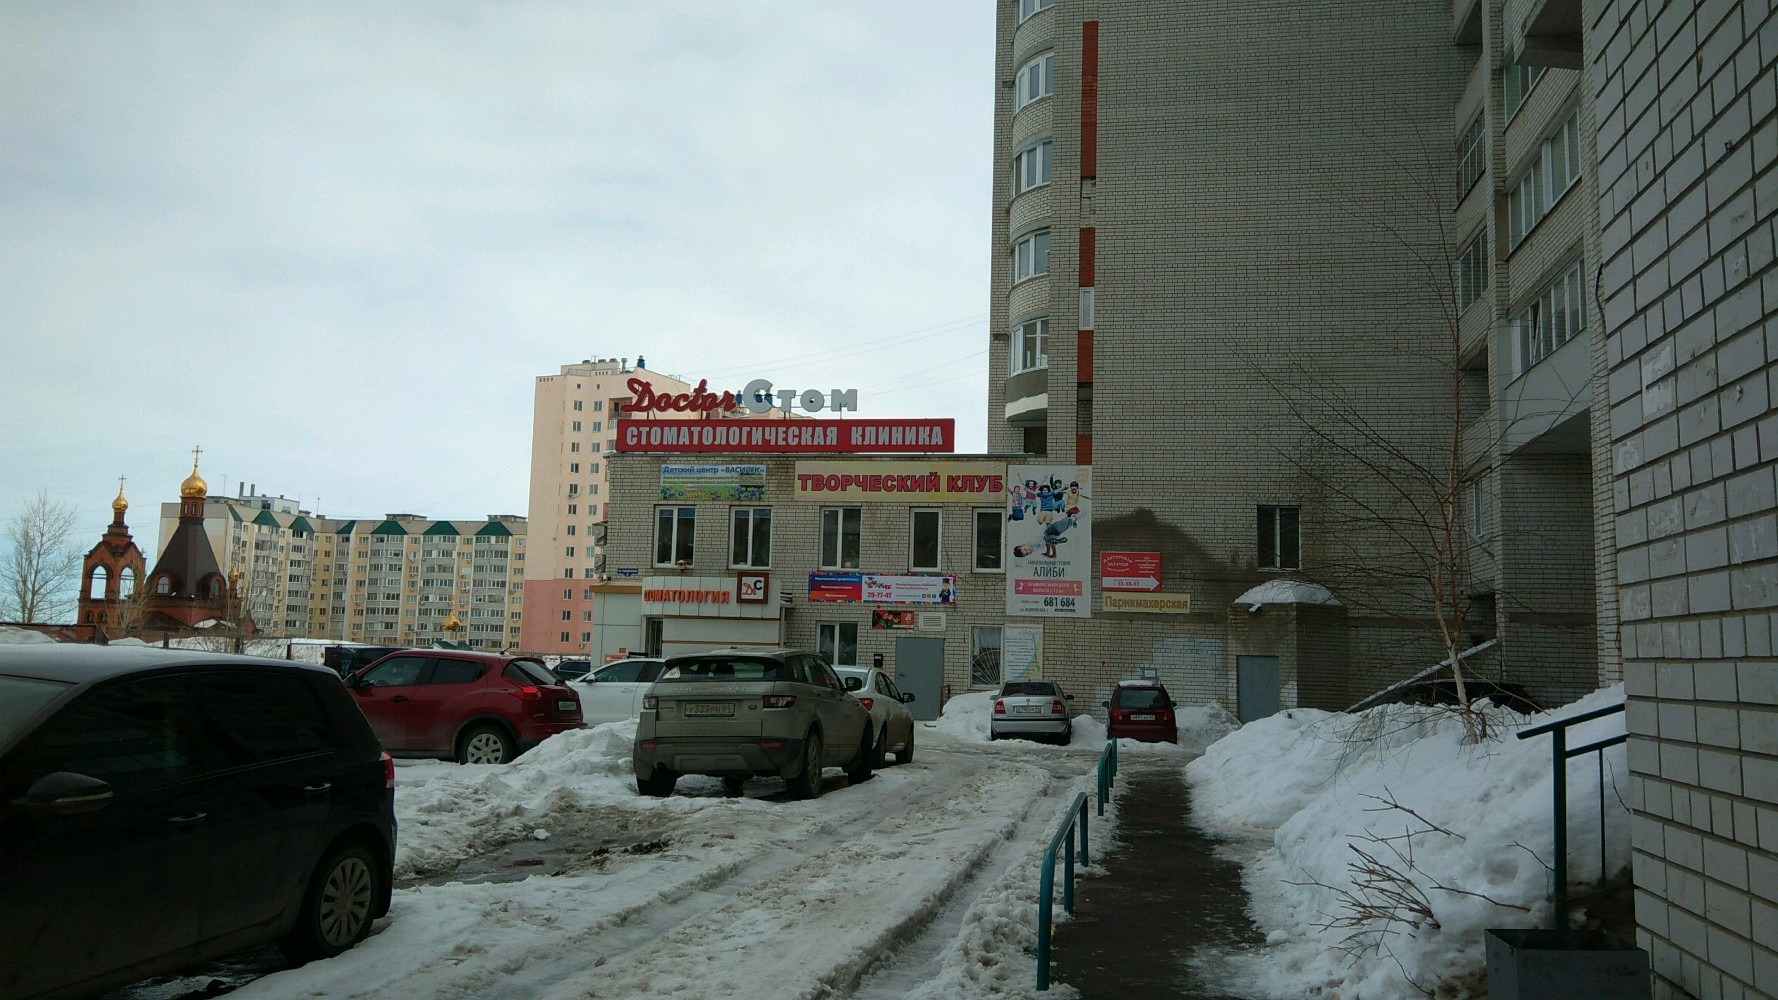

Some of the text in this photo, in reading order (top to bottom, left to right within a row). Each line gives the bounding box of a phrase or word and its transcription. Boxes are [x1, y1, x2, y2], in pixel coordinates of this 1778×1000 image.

[620, 377, 738, 414] Doctor
[626, 425, 944, 447] СТОМАТОЛОГИЧЕСКАЯ КЛИНИКА
[662, 465, 695, 475] Детский
[696, 467, 719, 475] центр
[797, 472, 1004, 493] ТВОРЧЕСКИЙ КЛУБ
[1033, 566, 1065, 578] АЛИБИ
[1044, 597, 1076, 608] 681 684
[1104, 595, 1189, 610] Парикмахерская
